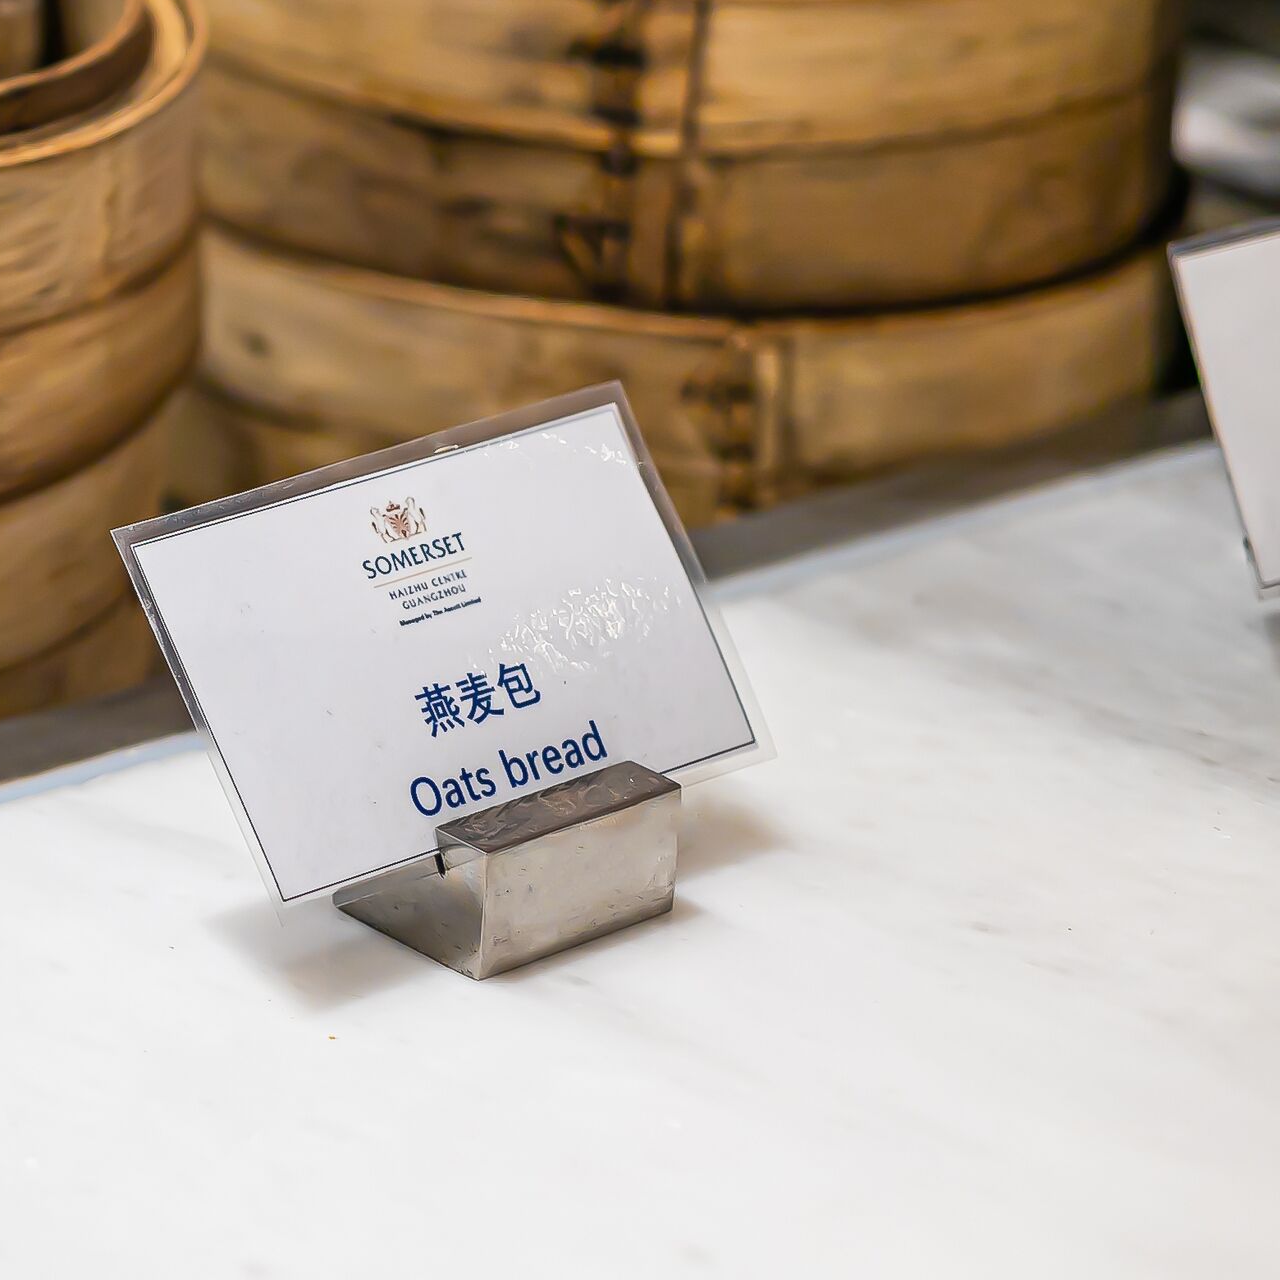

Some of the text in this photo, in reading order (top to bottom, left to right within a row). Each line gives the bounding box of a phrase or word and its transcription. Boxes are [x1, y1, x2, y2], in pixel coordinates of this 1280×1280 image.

[362, 531, 465, 580] SOMERSET
[389, 581, 429, 600] HAIZHU
[402, 583, 467, 610] GUANGZHOU
[414, 662, 542, 738] 燕麦包
[410, 720, 608, 817] Oats bread
